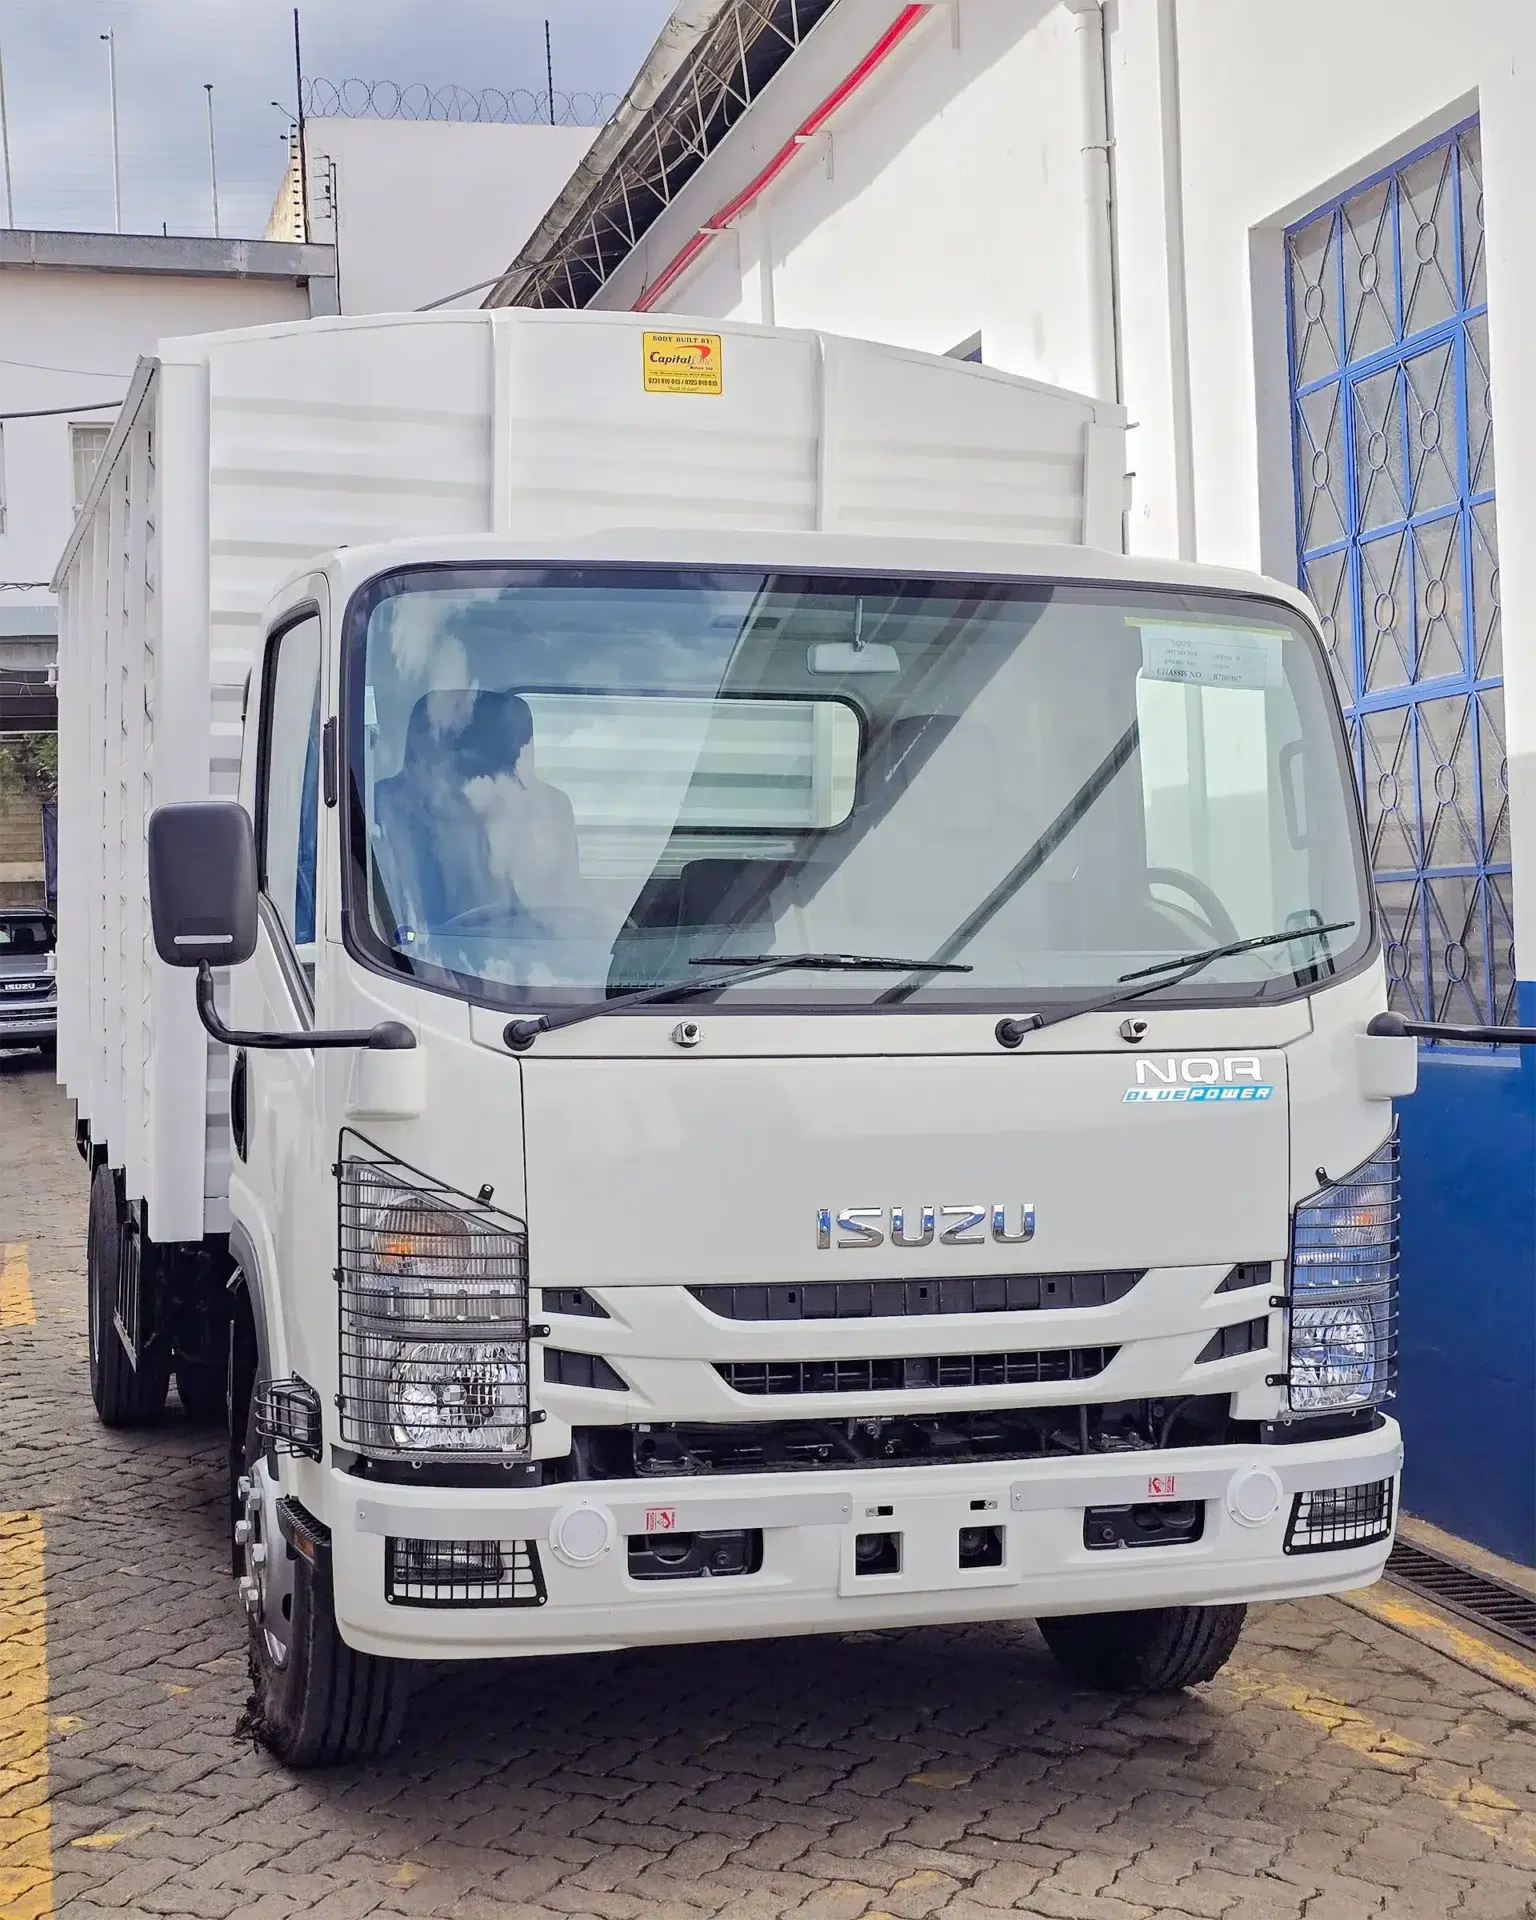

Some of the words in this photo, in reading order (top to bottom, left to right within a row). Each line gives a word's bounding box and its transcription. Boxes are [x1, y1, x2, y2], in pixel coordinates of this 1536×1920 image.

[1156, 667, 1188, 677] CHASSIS
[1190, 671, 1202, 679] NO
[4, 982, 36, 991] ISUZU
[1135, 1056, 1263, 1085] NQR
[816, 1203, 1036, 1249] ISUZU
